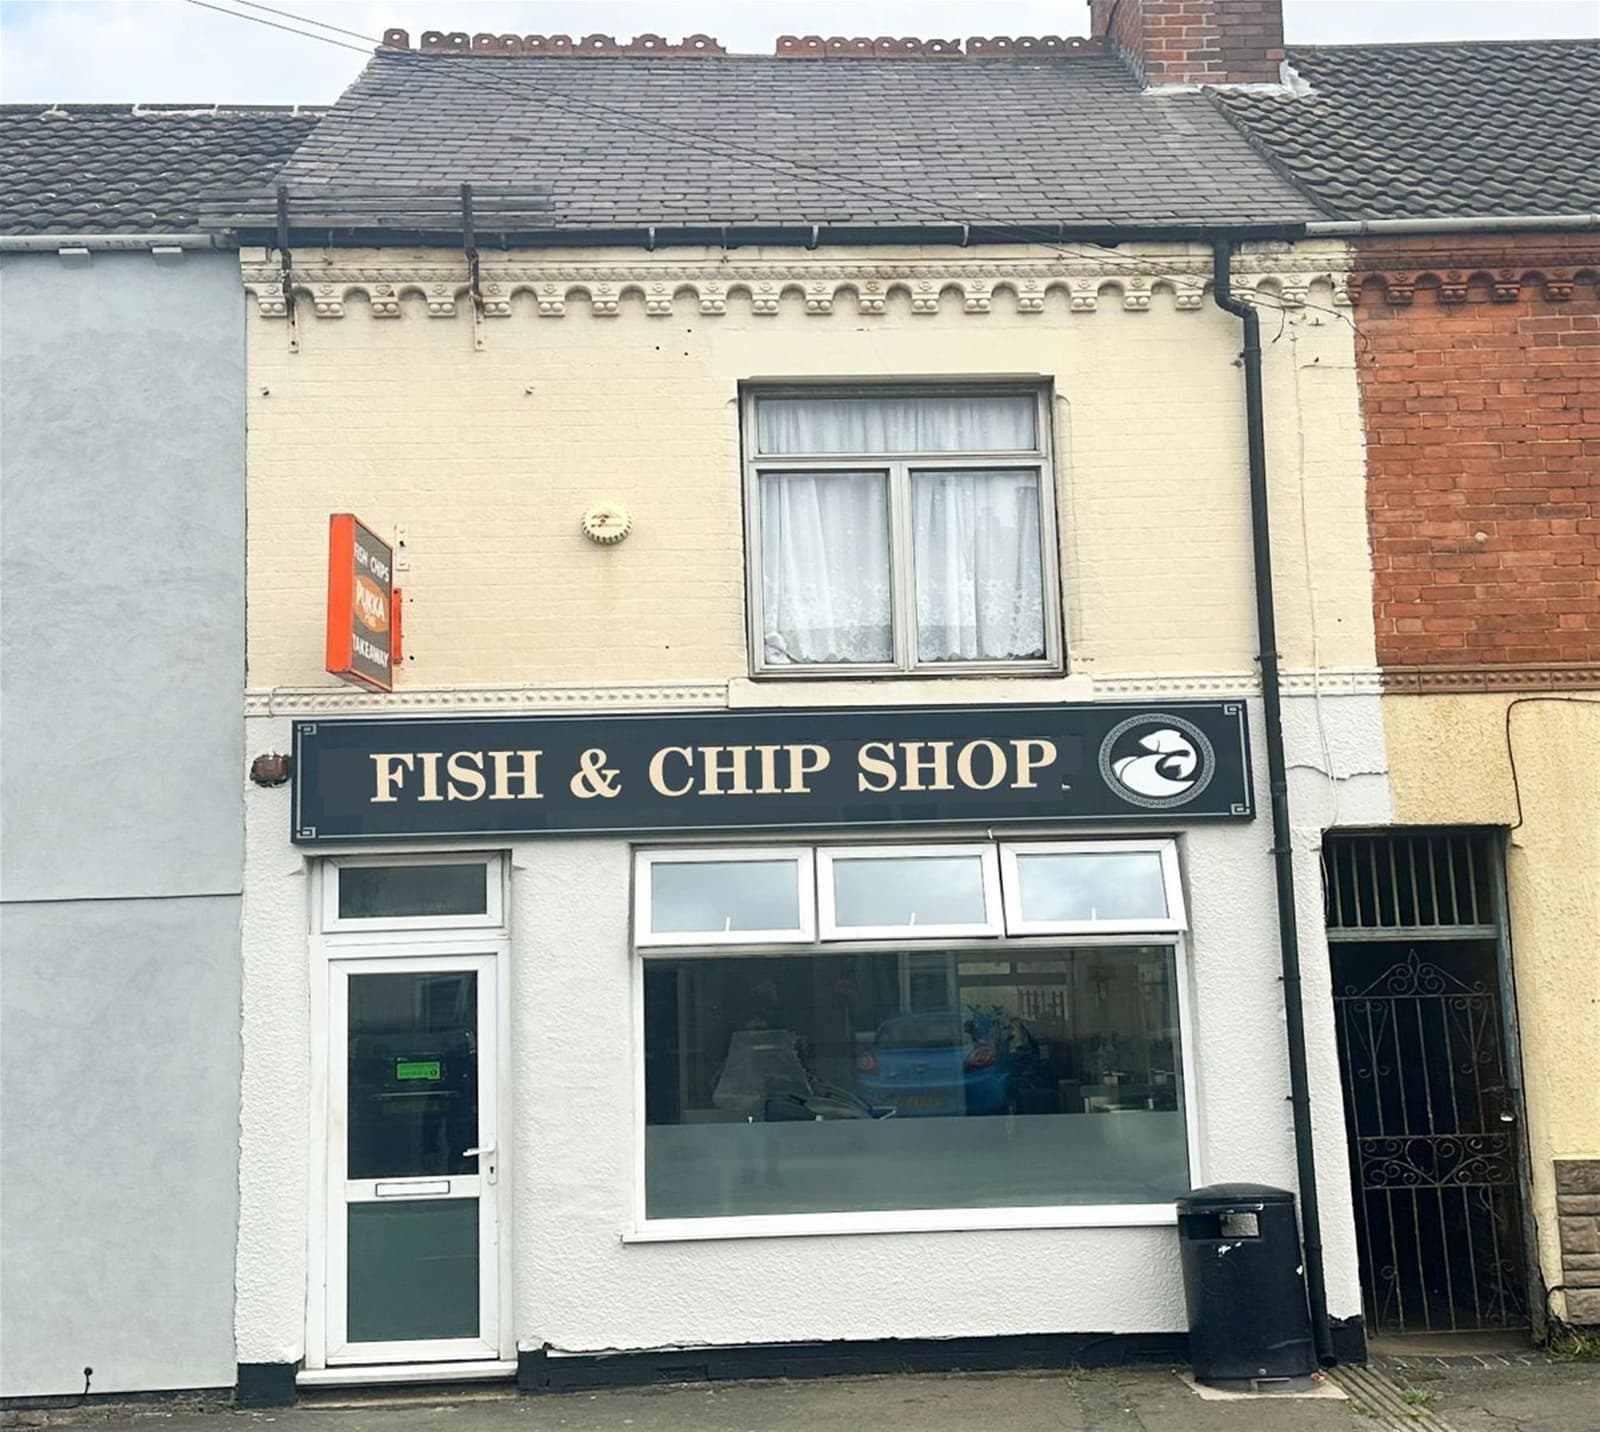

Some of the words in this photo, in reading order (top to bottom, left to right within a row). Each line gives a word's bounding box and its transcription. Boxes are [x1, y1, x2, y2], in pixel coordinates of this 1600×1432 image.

[354, 541, 369, 568] FISH
[370, 556, 389, 583] CHIPS
[356, 579, 385, 622] PUKKA
[352, 633, 389, 668] TAKEAWAY
[368, 749, 545, 804] FISH
[570, 747, 622, 799] &
[647, 743, 832, 798] CHIP
[857, 738, 1058, 793] SHOP
